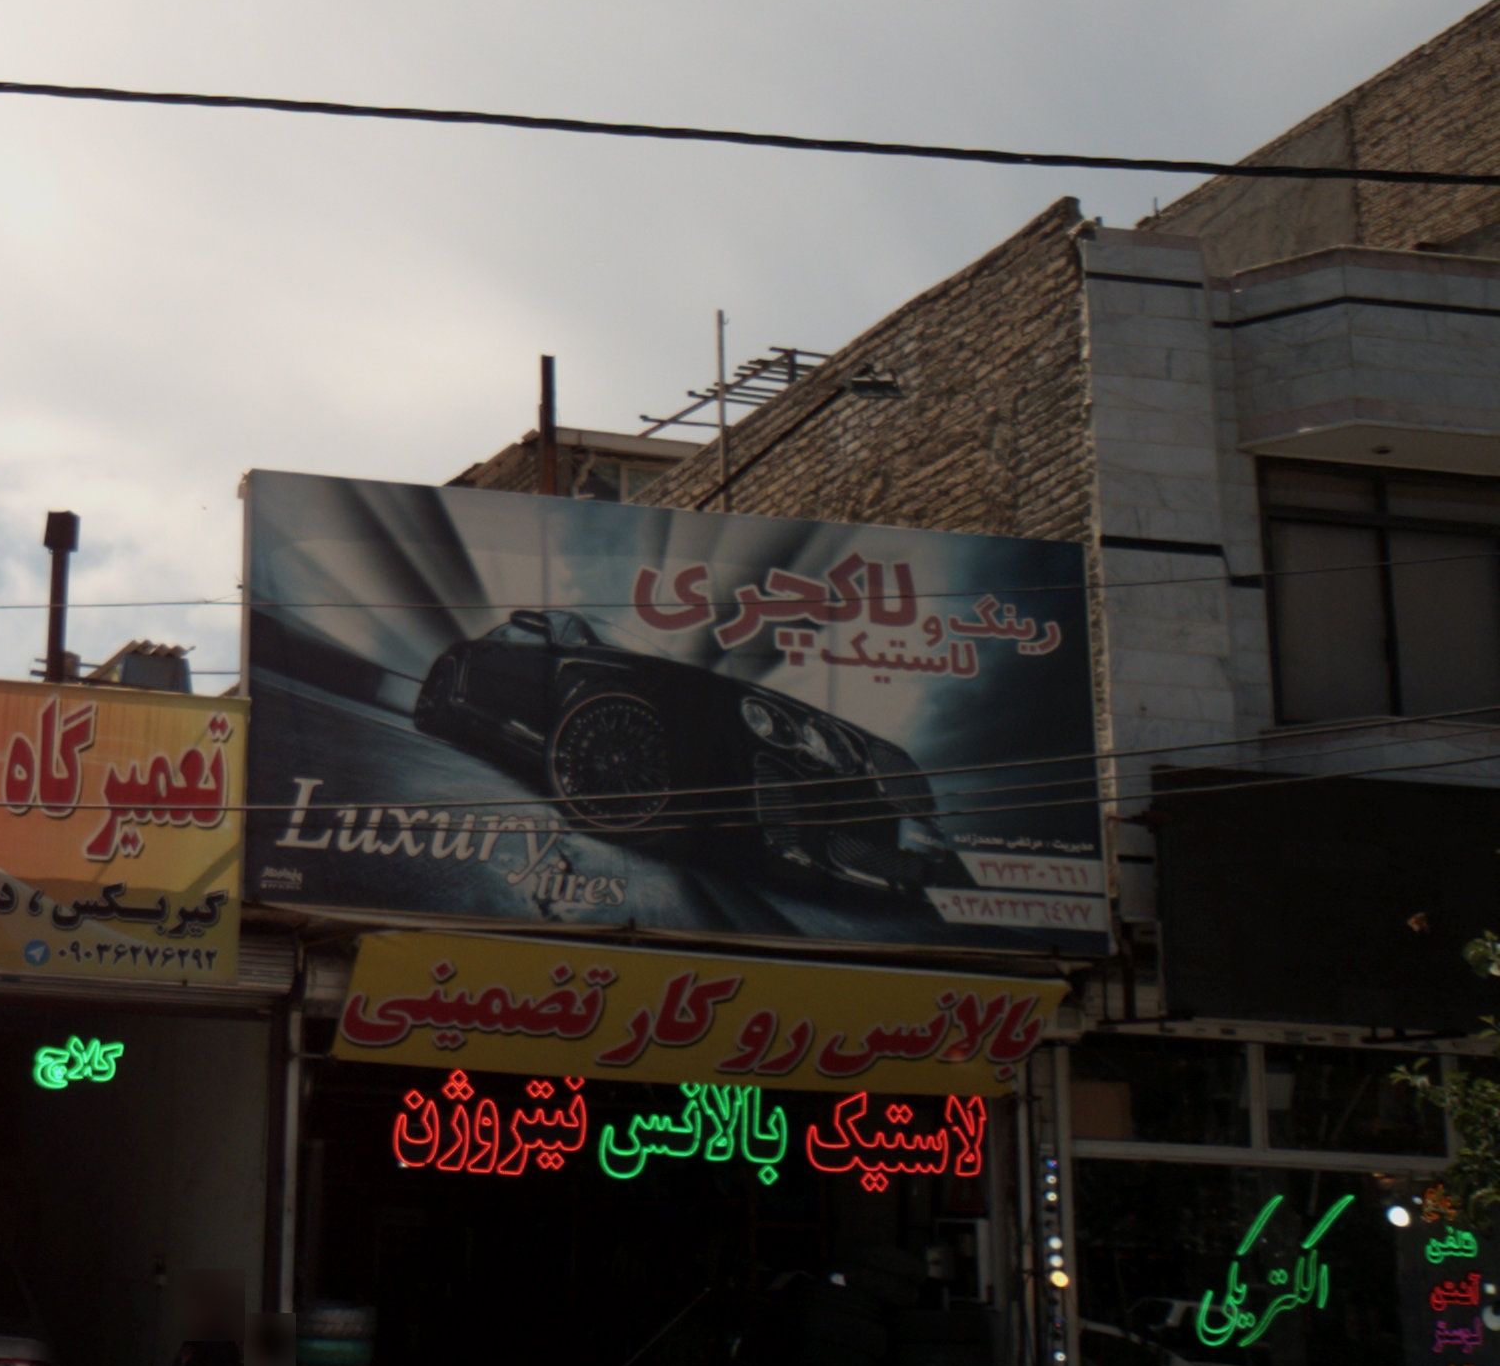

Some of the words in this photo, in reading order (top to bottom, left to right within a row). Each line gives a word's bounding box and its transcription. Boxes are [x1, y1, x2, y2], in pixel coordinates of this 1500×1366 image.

[633, 552, 918, 667] لاکچری
[922, 612, 943, 647] و
[949, 594, 1062, 654] رینگ
[820, 633, 979, 684] لاستیک
[276, 777, 560, 885] Luxury
[535, 859, 628, 906] tires
[341, 958, 616, 1049] تضمینی
[596, 971, 743, 1065] کار
[717, 1007, 813, 1076] رو
[816, 987, 1046, 1080] بالانس
[392, 1068, 588, 1176] نیتروژن
[599, 1082, 789, 1187] بالانس
[806, 1091, 986, 1193] لاستیک
[1199, 1194, 1355, 1347] الکتریکی
